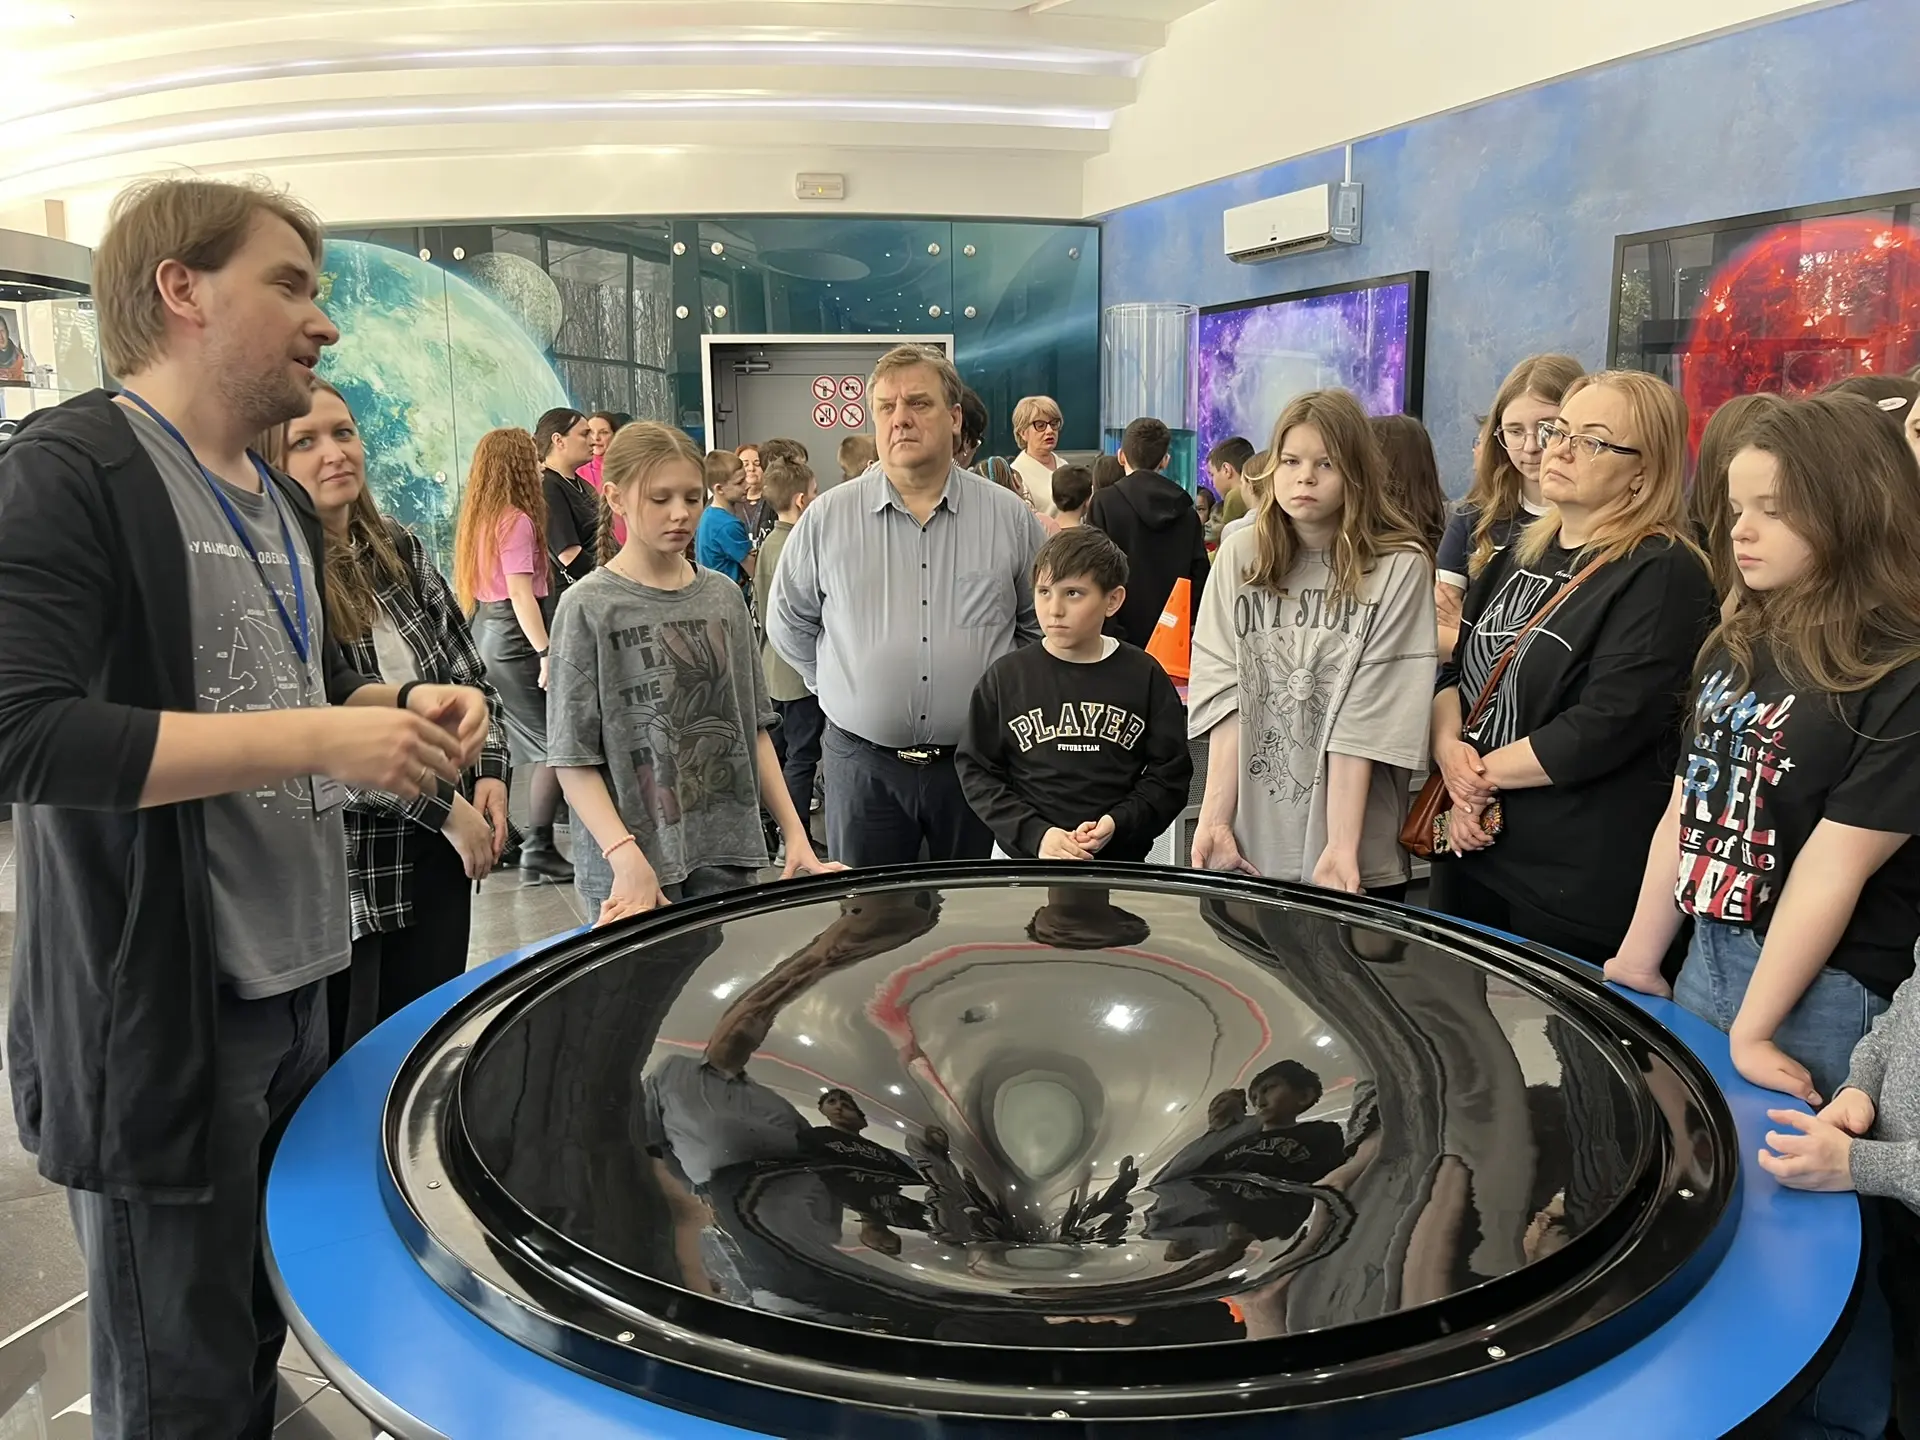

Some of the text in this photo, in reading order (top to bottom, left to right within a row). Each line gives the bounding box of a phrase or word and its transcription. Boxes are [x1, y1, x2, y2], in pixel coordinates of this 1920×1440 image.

[1234, 588, 1288, 639] ON'T
[608, 625, 652, 650] THE
[618, 680, 663, 707] THE
[1008, 702, 1145, 752] PLAYER
[1057, 743, 1082, 751] FUTURE
[1694, 729, 1756, 762] of the
[1680, 753, 1783, 846] REE
[1680, 826, 1775, 870] SE of the
[1677, 864, 1752, 919] AVE
